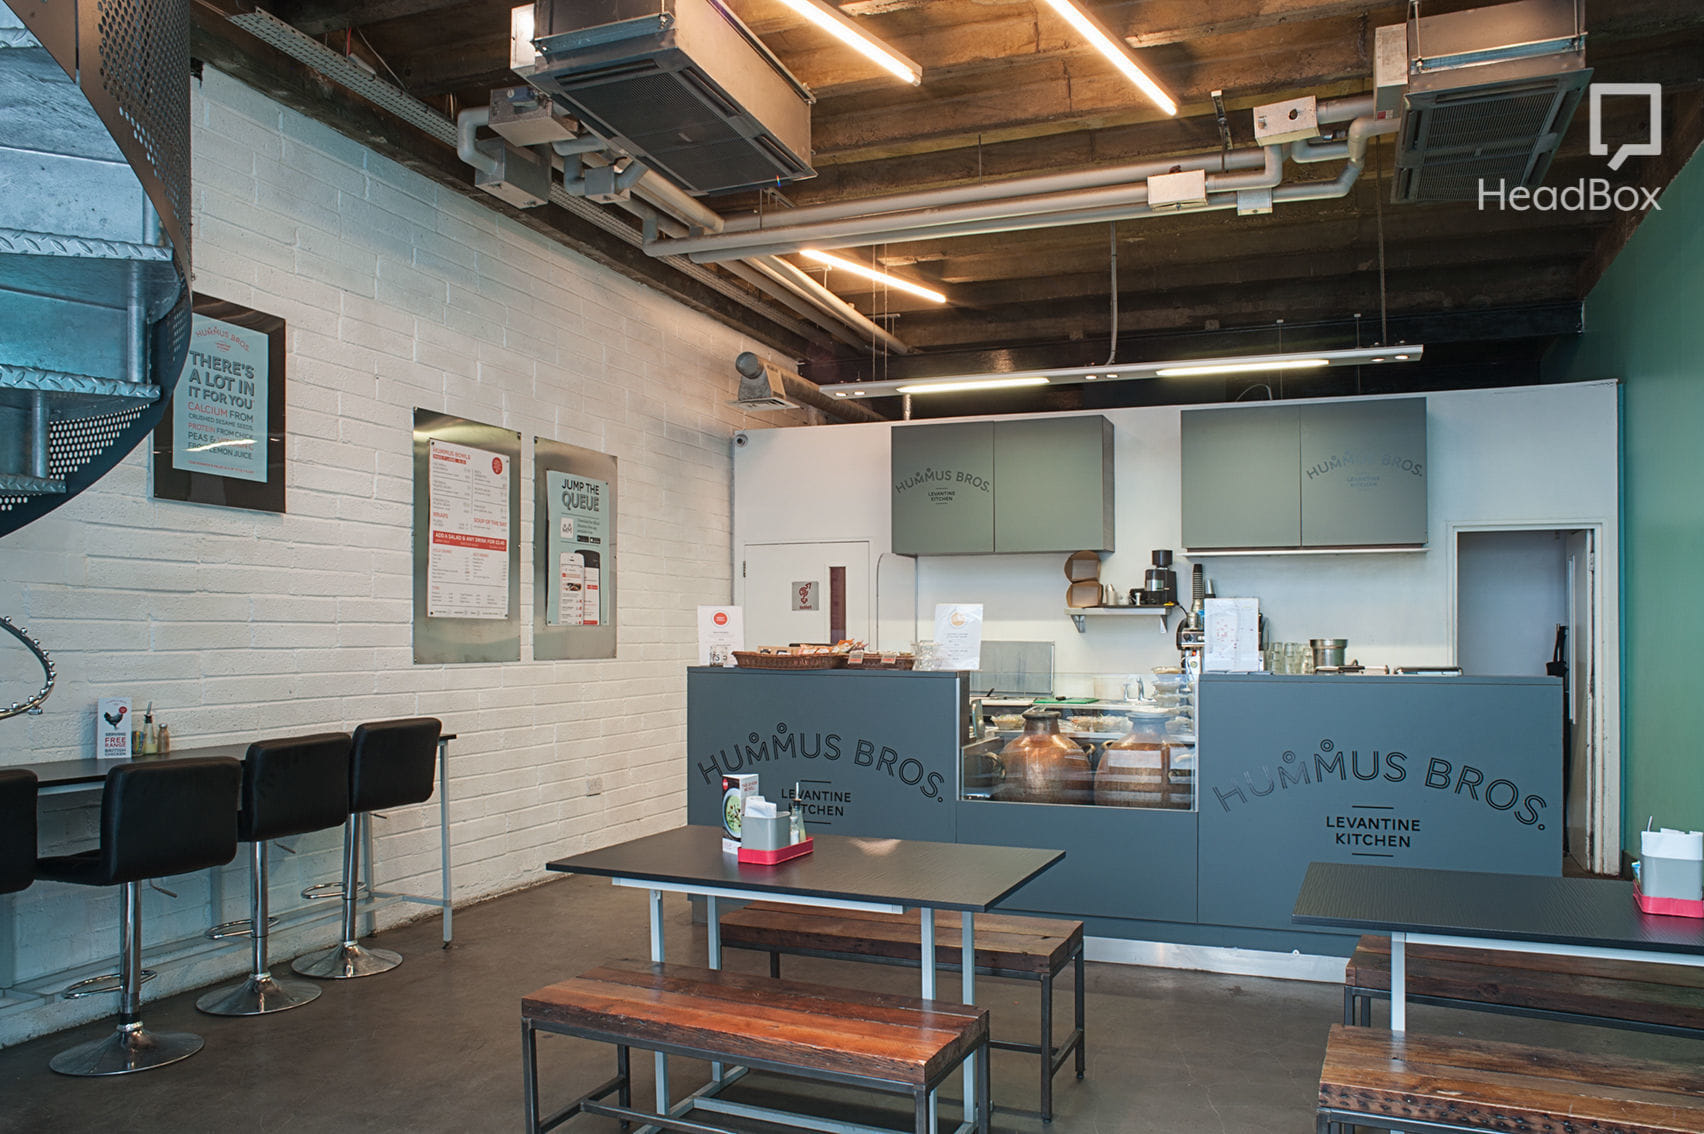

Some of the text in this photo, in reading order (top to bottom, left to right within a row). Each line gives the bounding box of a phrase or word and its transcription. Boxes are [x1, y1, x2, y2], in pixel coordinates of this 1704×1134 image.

[189, 350, 255, 379] THERE'S
[189, 368, 255, 396] A LOT IN
[189, 386, 253, 410] IT FOR YOU
[188, 401, 254, 423] CALCIUM FROM
[188, 422, 215, 433] PROTEIN
[216, 427, 234, 436] FROM
[188, 431, 208, 442] PEAS
[188, 442, 208, 452] FRO
[1306, 449, 1375, 479] HUMM
[562, 479, 599, 496] JUMP THE
[895, 467, 990, 494] HUMMUS BROS.
[561, 491, 600, 512] QUEUE
[697, 722, 945, 803] HUMMUS BROS.
[1211, 738, 1547, 831] HUMMUS BROS.
[788, 803, 844, 817] TCHEN
[1326, 815, 1421, 832] LEVANTINE
[1335, 833, 1411, 848] KITCHEN
